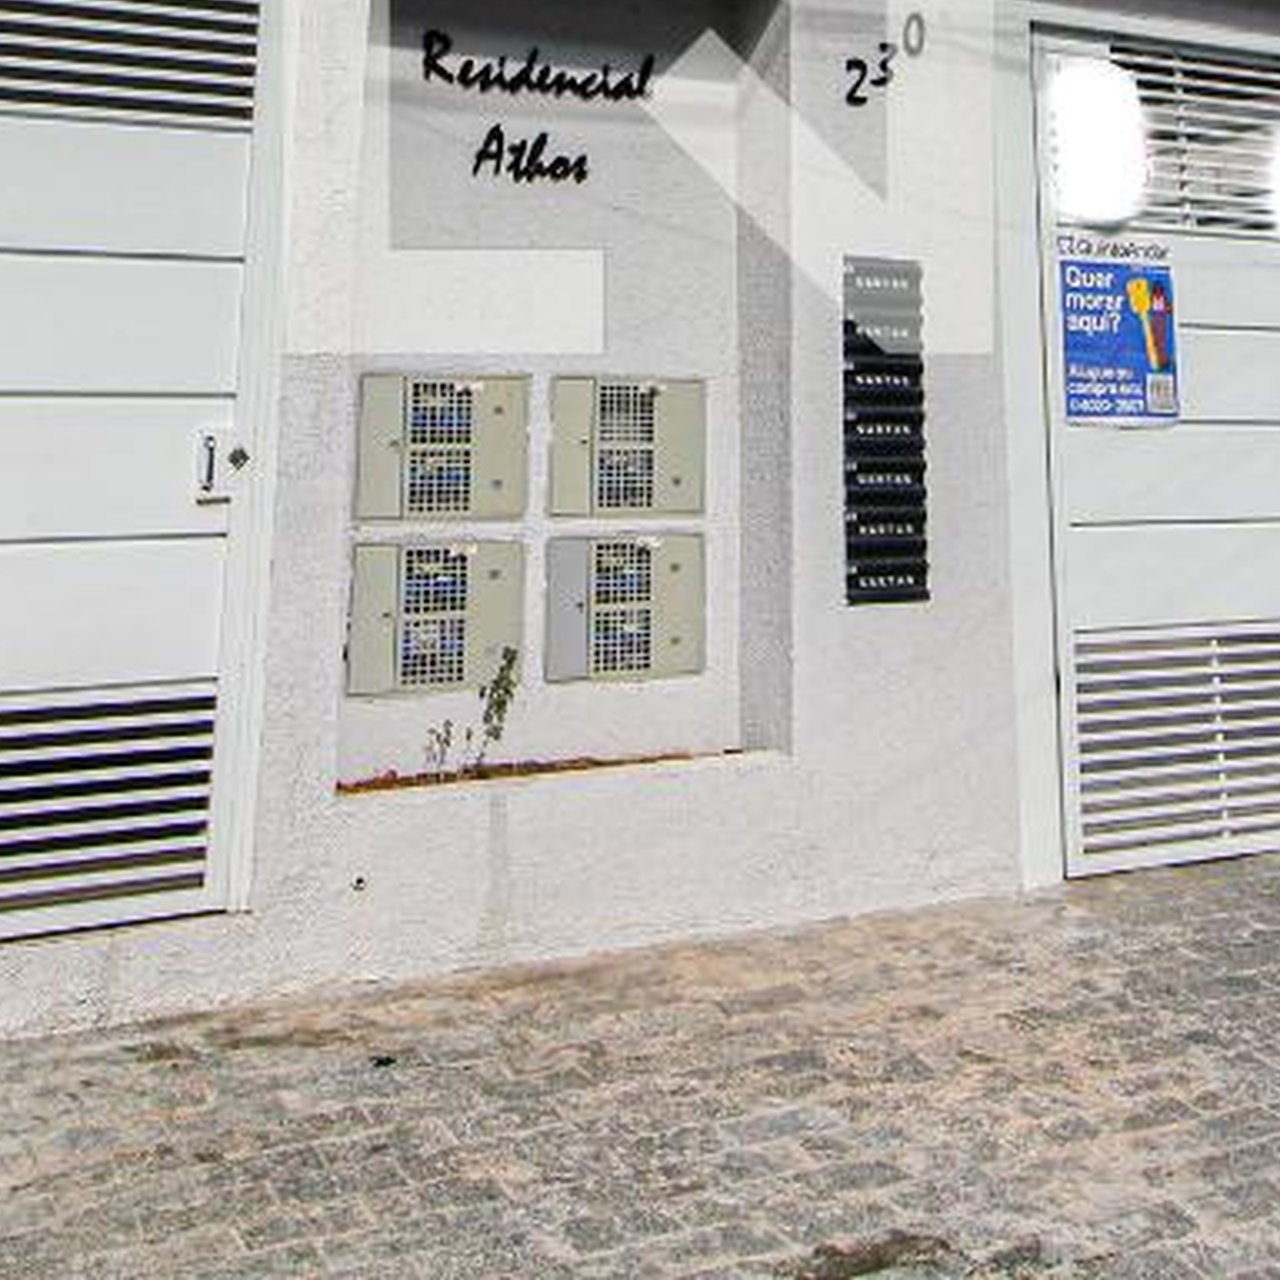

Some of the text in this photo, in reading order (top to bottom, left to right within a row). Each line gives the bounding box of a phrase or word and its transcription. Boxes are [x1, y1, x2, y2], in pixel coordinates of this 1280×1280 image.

[422, 29, 655, 100] Residencial
[845, 12, 925, 105] 230
[472, 123, 588, 184] Athos
[1065, 266, 1114, 289] Quer
[1066, 311, 1121, 334] aqui?
